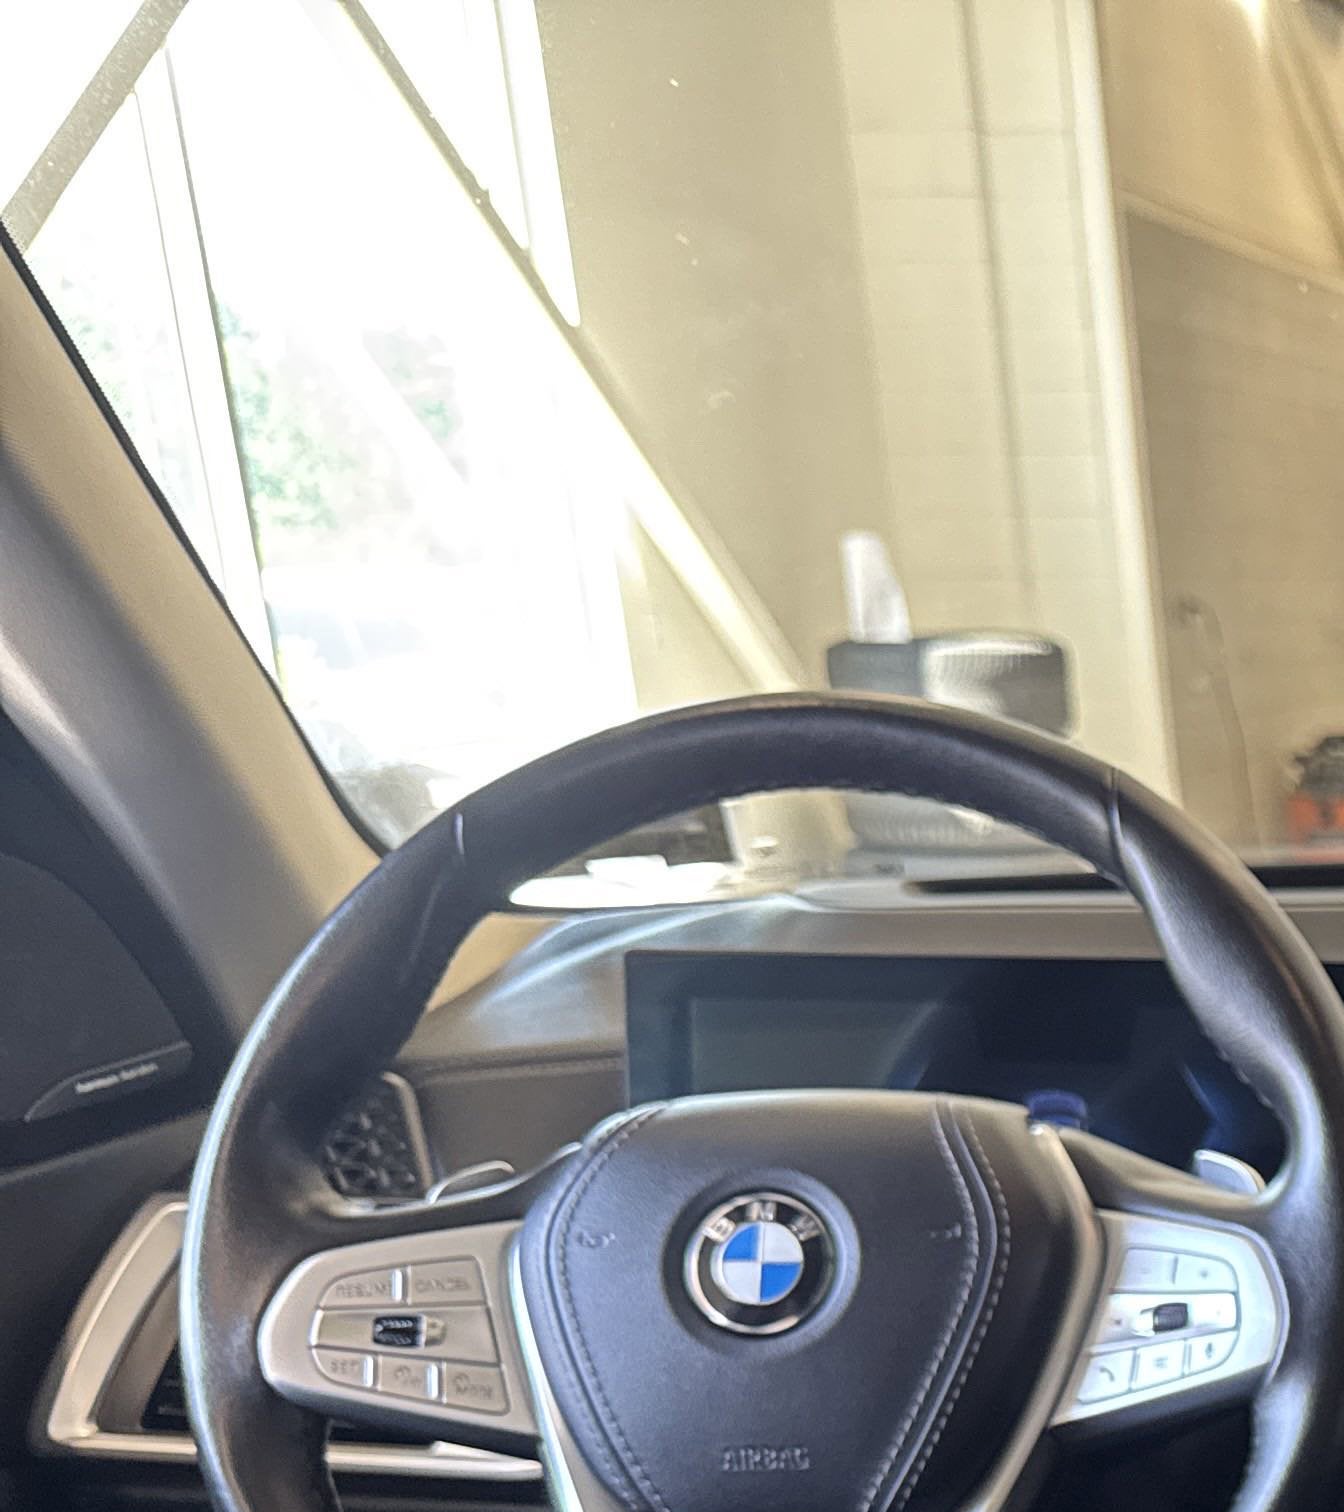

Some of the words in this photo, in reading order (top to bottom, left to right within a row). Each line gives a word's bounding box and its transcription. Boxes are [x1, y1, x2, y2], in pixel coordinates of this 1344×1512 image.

[702, 1199, 823, 1242] BMW
[414, 1279, 472, 1295] CANCEL
[330, 1360, 359, 1375] SET
[722, 1446, 810, 1473] AIRBAG
